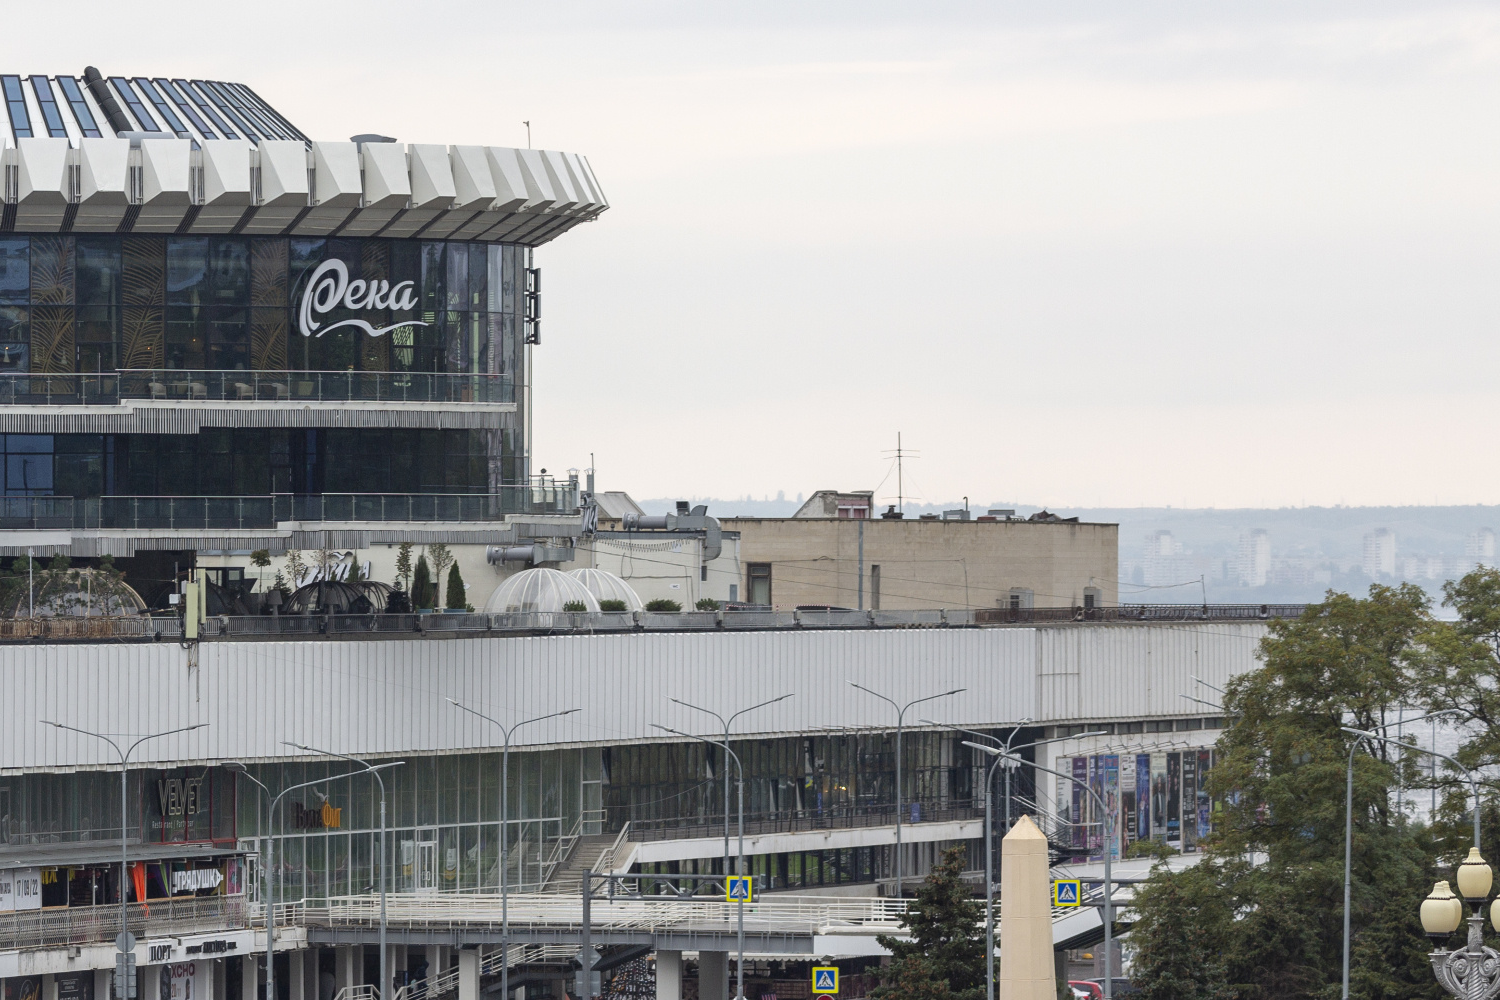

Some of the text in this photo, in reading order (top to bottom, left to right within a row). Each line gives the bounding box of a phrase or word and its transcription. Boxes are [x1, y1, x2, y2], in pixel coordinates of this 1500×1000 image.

[299, 258, 419, 337] Река
[158, 777, 203, 816] VELVET
[151, 820, 173, 829] Restarant
[149, 944, 172, 962] ПОРТ
